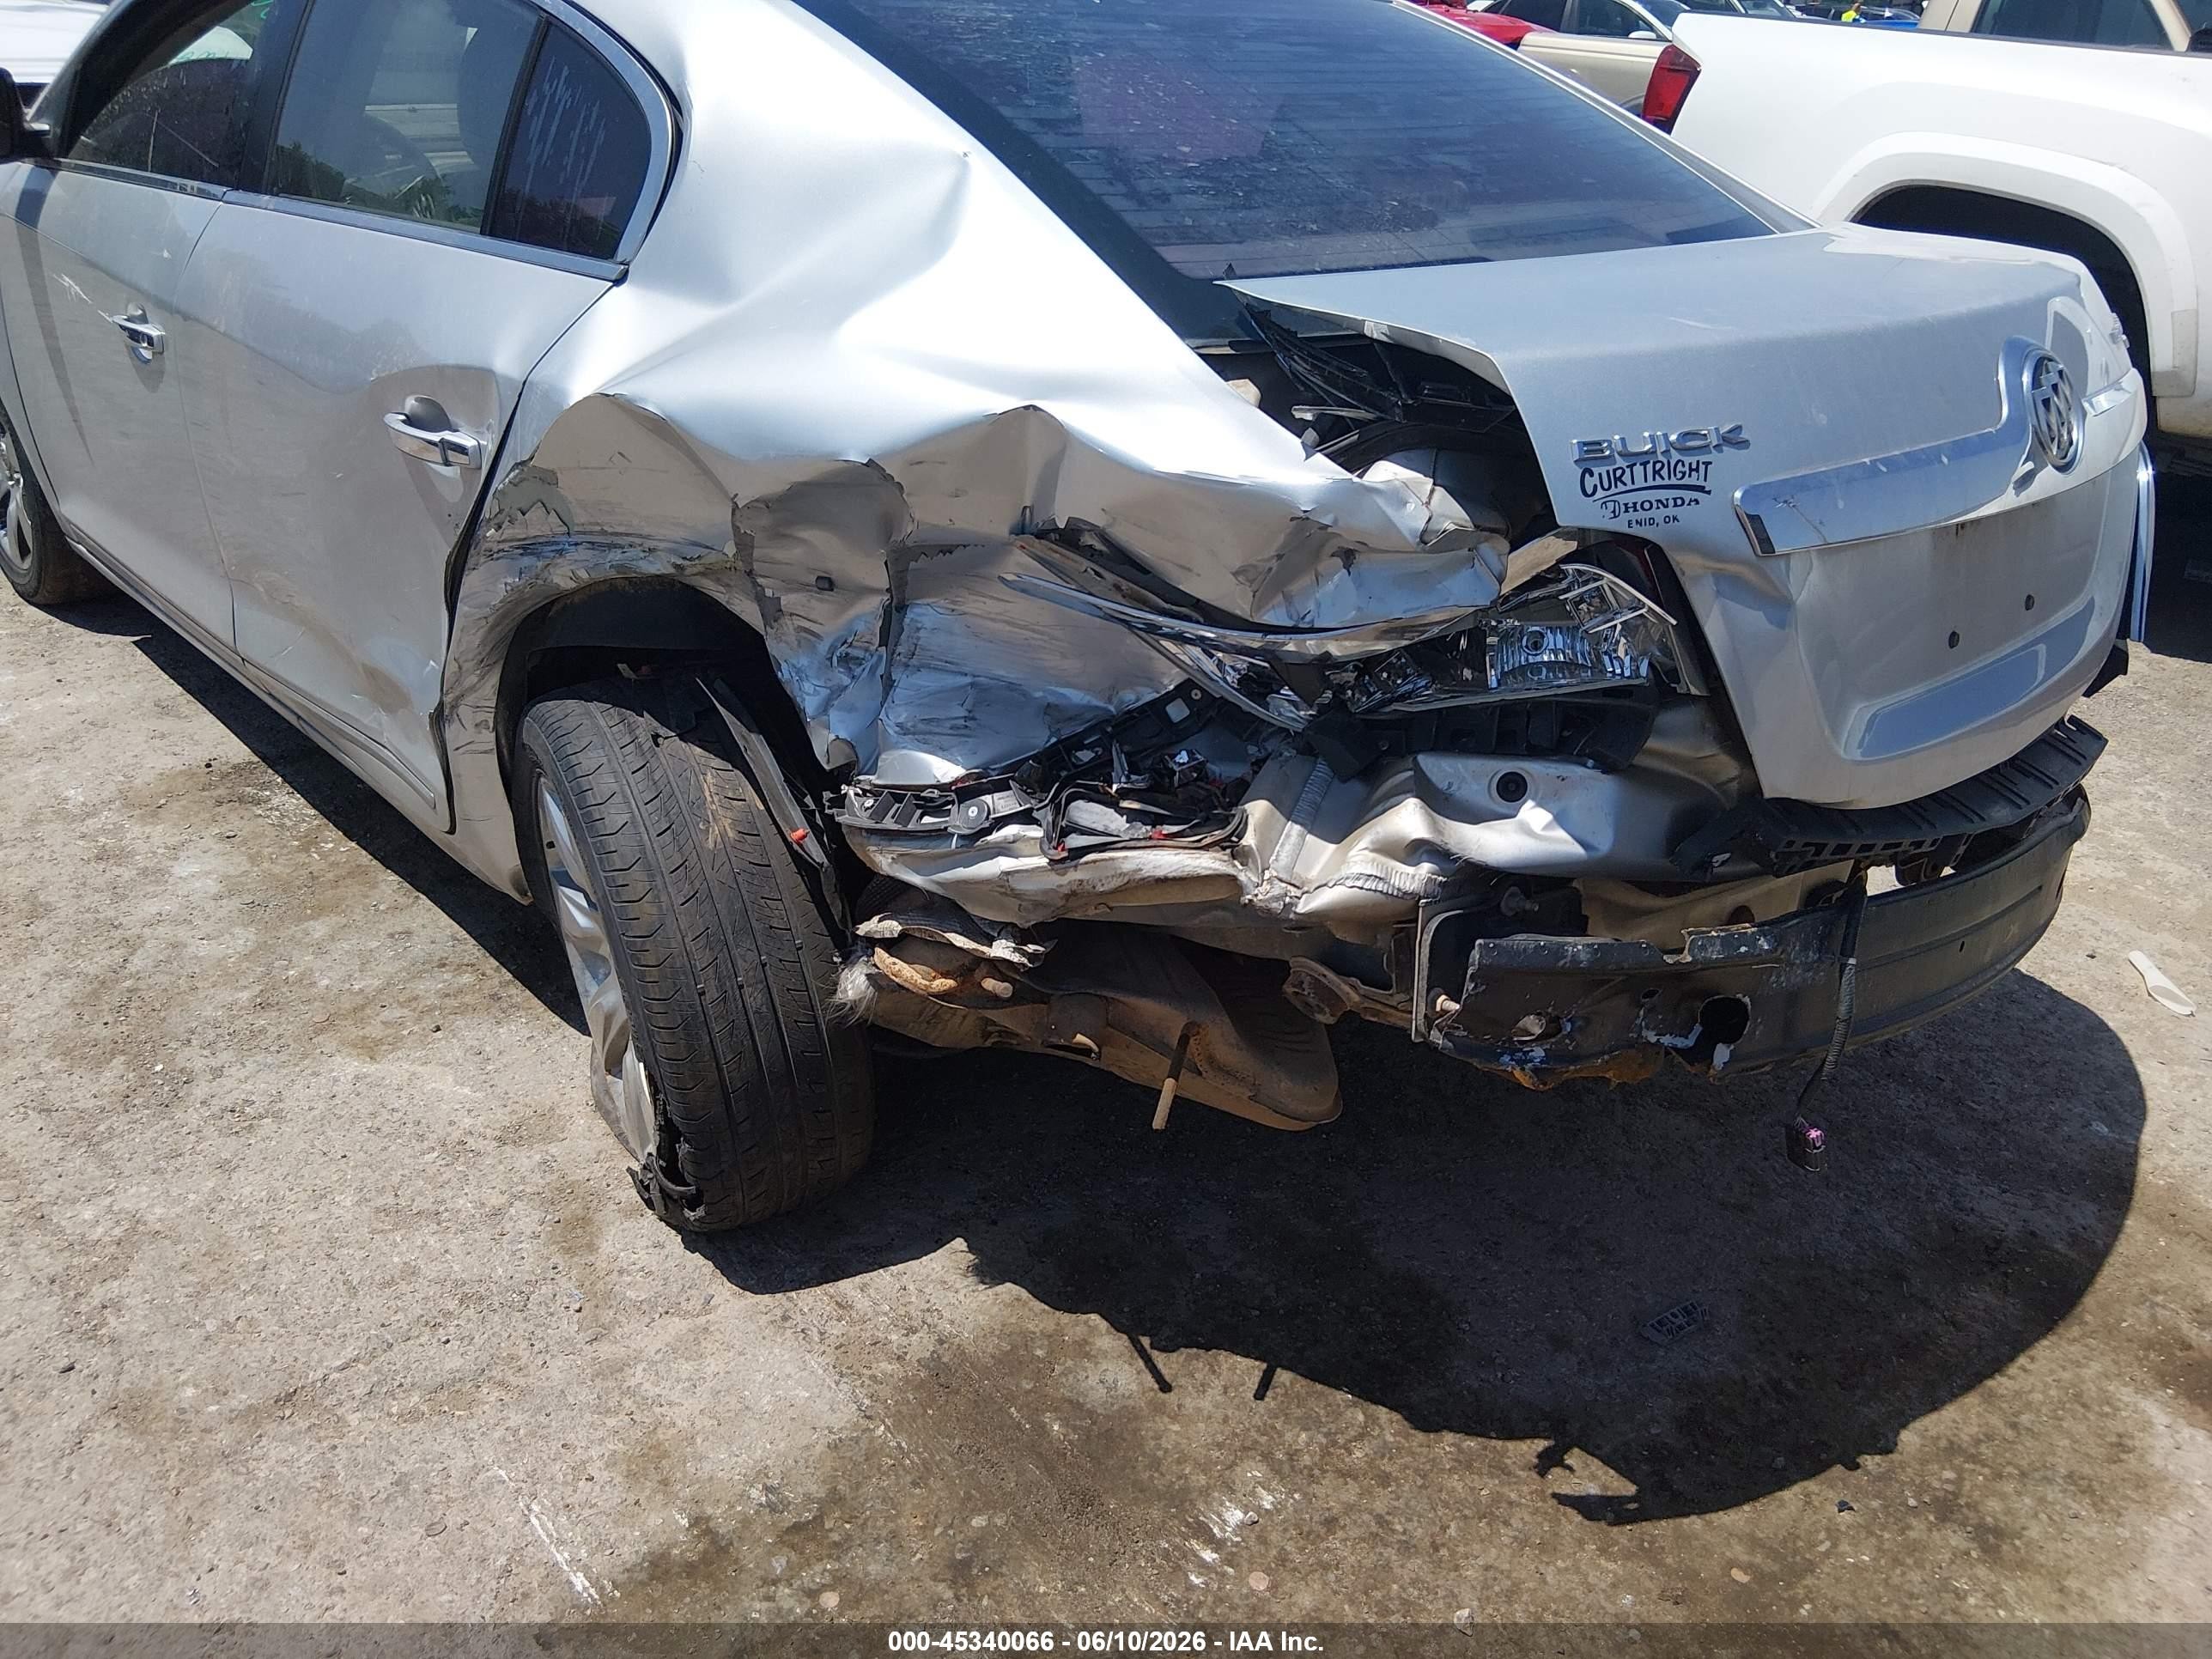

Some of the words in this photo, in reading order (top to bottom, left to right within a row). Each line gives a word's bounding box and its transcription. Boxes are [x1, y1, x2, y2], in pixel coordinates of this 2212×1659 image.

[1571, 424, 1750, 462] BUICK
[1580, 459, 1713, 498] CURTTRIGHT
[1622, 496, 1700, 514] HONDA
[1627, 517, 1659, 528] ENID,
[1663, 514, 1680, 525] OK
